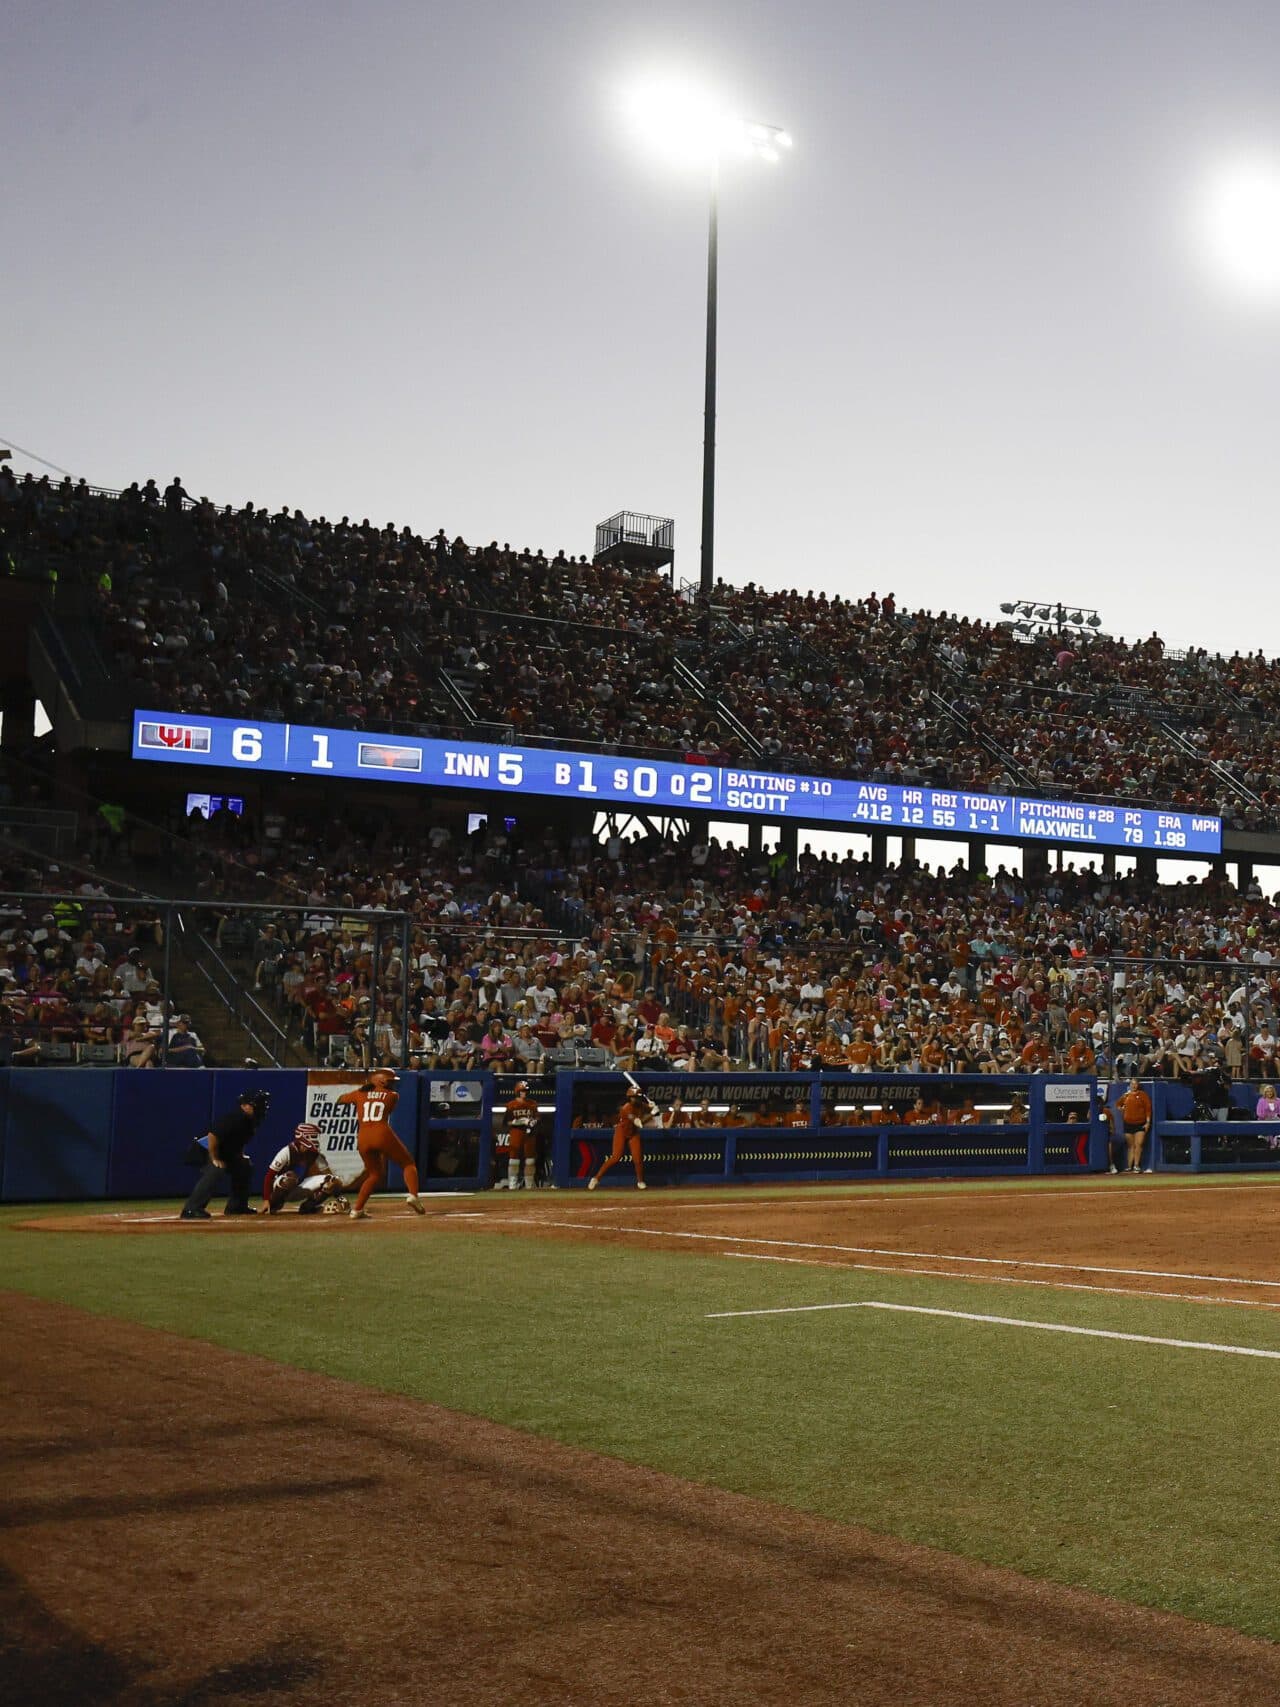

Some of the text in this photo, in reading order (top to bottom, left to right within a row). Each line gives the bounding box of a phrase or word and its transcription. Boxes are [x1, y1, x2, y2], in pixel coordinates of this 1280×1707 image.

[232, 727, 262, 762] 6
[312, 734, 333, 769] 1
[444, 752, 523, 786] INN 5
[555, 760, 597, 793] B 1
[613, 769, 628, 790] S
[690, 772, 713, 803] 2
[727, 772, 796, 793] BATTING
[727, 790, 789, 812] SCOTT
[858, 786, 1007, 813] AVG HR RBI TODAY
[852, 802, 1000, 831] .412 12 55 1-1
[1020, 802, 1084, 820] PITCHING
[1020, 818, 1097, 840] MAXWELL
[1125, 812, 1219, 833] PC ERA MPH
[1123, 827, 1186, 848] 79 1.98
[313, 1093, 328, 1102] THE
[367, 1091, 388, 1100] SCOTT
[648, 1086, 681, 1100] 2024
[684, 1086, 718, 1100] NCAA
[721, 1086, 780, 1100] WOMEN'S
[837, 1086, 878, 1100] WORLD
[880, 1086, 921, 1100] SERIES
[362, 1101, 386, 1123] 10
[326, 1135, 359, 1151] DIR
